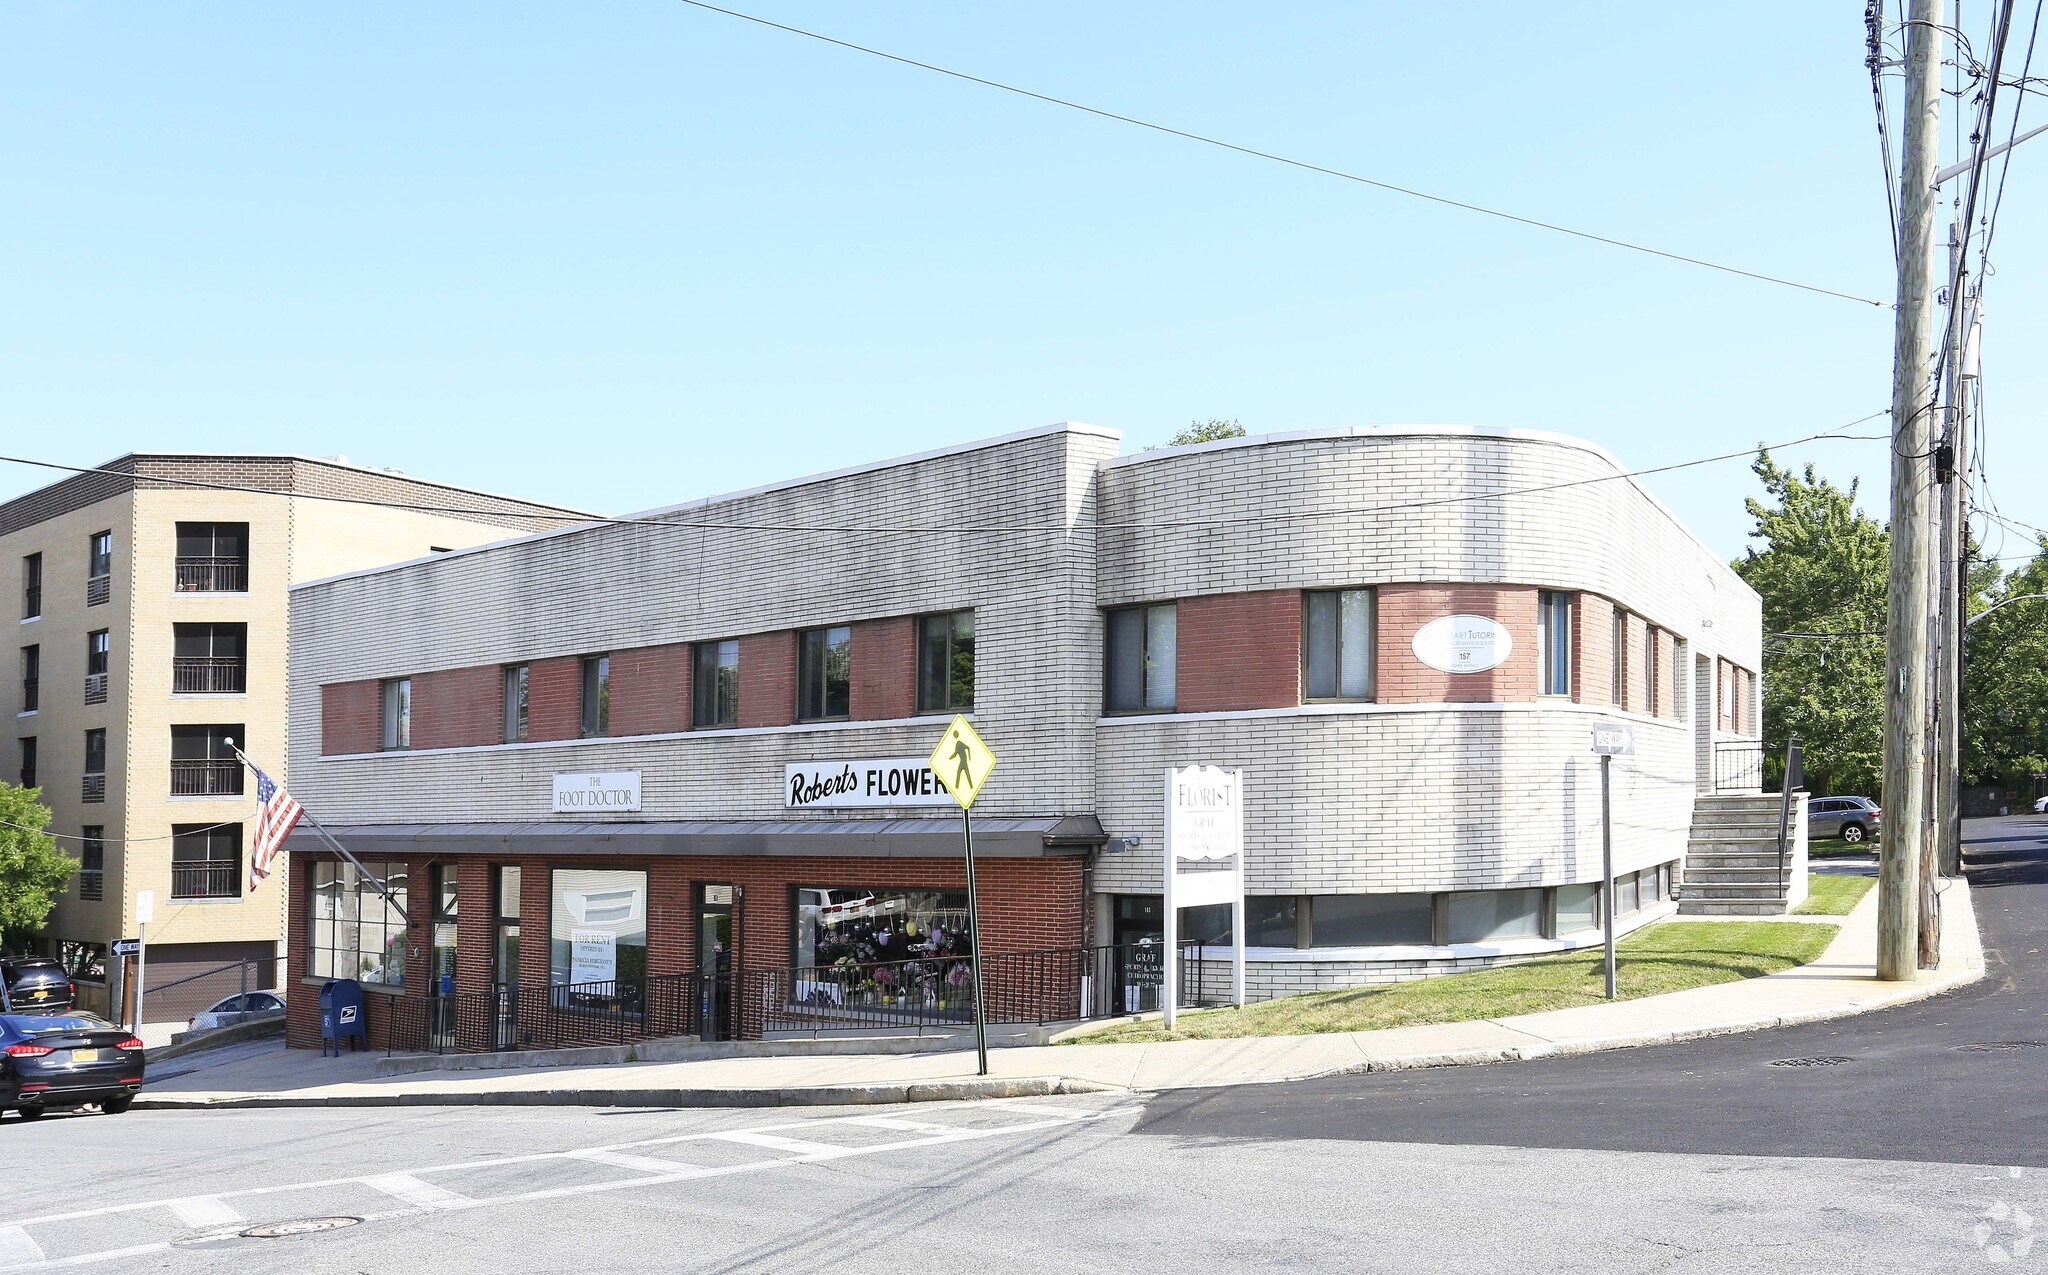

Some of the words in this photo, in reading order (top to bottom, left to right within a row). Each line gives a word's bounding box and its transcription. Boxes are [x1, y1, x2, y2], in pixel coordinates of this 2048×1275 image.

[1468, 630, 1498, 639] TUTORIN
[1597, 731, 1609, 745] ONE
[1611, 732, 1623, 746] WAY
[589, 777, 601, 786] THE
[790, 763, 858, 807] Roberts
[866, 768, 951, 797] FLOWER
[559, 791, 585, 806] FOOT
[588, 789, 633, 806] DOCTOR
[1179, 784, 1232, 807] FLORIST
[575, 934, 590, 944] FOR
[591, 935, 610, 946] RENT
[1135, 953, 1157, 963] GRAF
